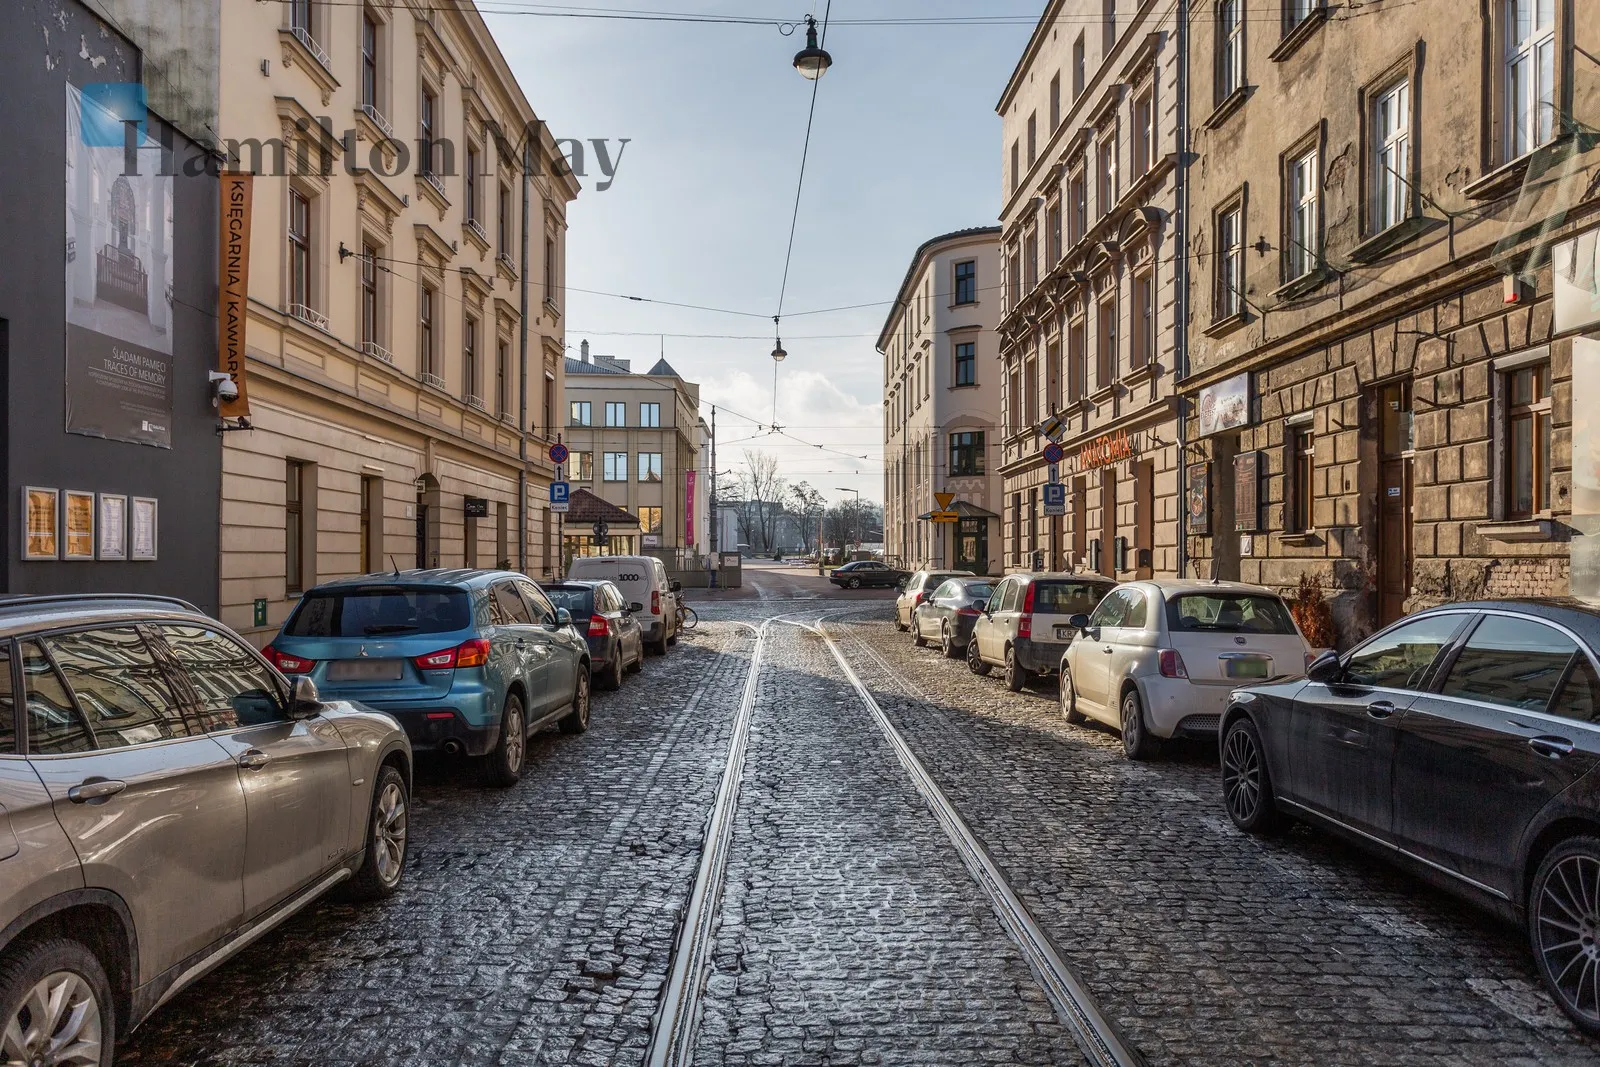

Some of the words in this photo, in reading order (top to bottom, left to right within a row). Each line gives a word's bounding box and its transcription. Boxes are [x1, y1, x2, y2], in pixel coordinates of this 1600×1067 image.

[226, 180, 245, 287] KSIĘGARNIA
[112, 345, 141, 366] ŚLADAMI
[227, 301, 240, 400] KAWIARN
[103, 358, 128, 375] TRACES
[129, 365, 138, 377] OF
[139, 368, 166, 385] MEMORY
[1080, 427, 1131, 470] ANATOMIA
[553, 484, 565, 500] P
[1049, 486, 1061, 502] P
[619, 573, 639, 581] 1000
